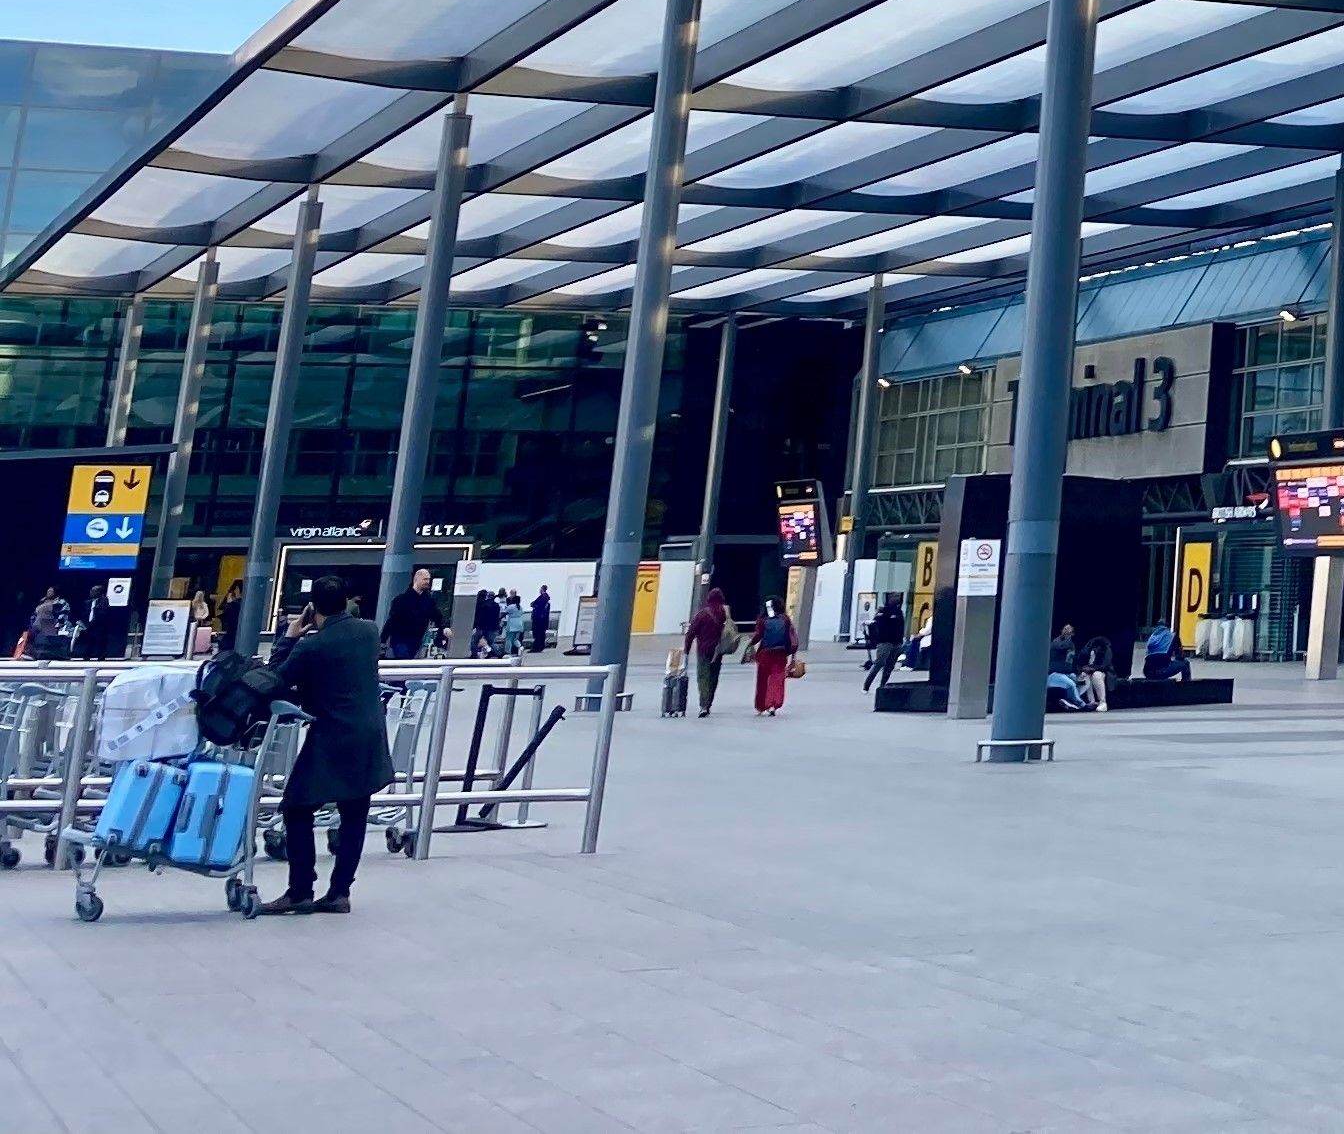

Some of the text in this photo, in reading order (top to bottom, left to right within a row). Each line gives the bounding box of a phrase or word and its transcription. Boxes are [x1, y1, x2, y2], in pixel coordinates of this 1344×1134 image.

[1149, 356, 1176, 432] 3
[290, 526, 362, 539] virgin atlantic
[415, 524, 466, 537] ELTA
[922, 546, 934, 587] B
[1187, 567, 1203, 613] D
